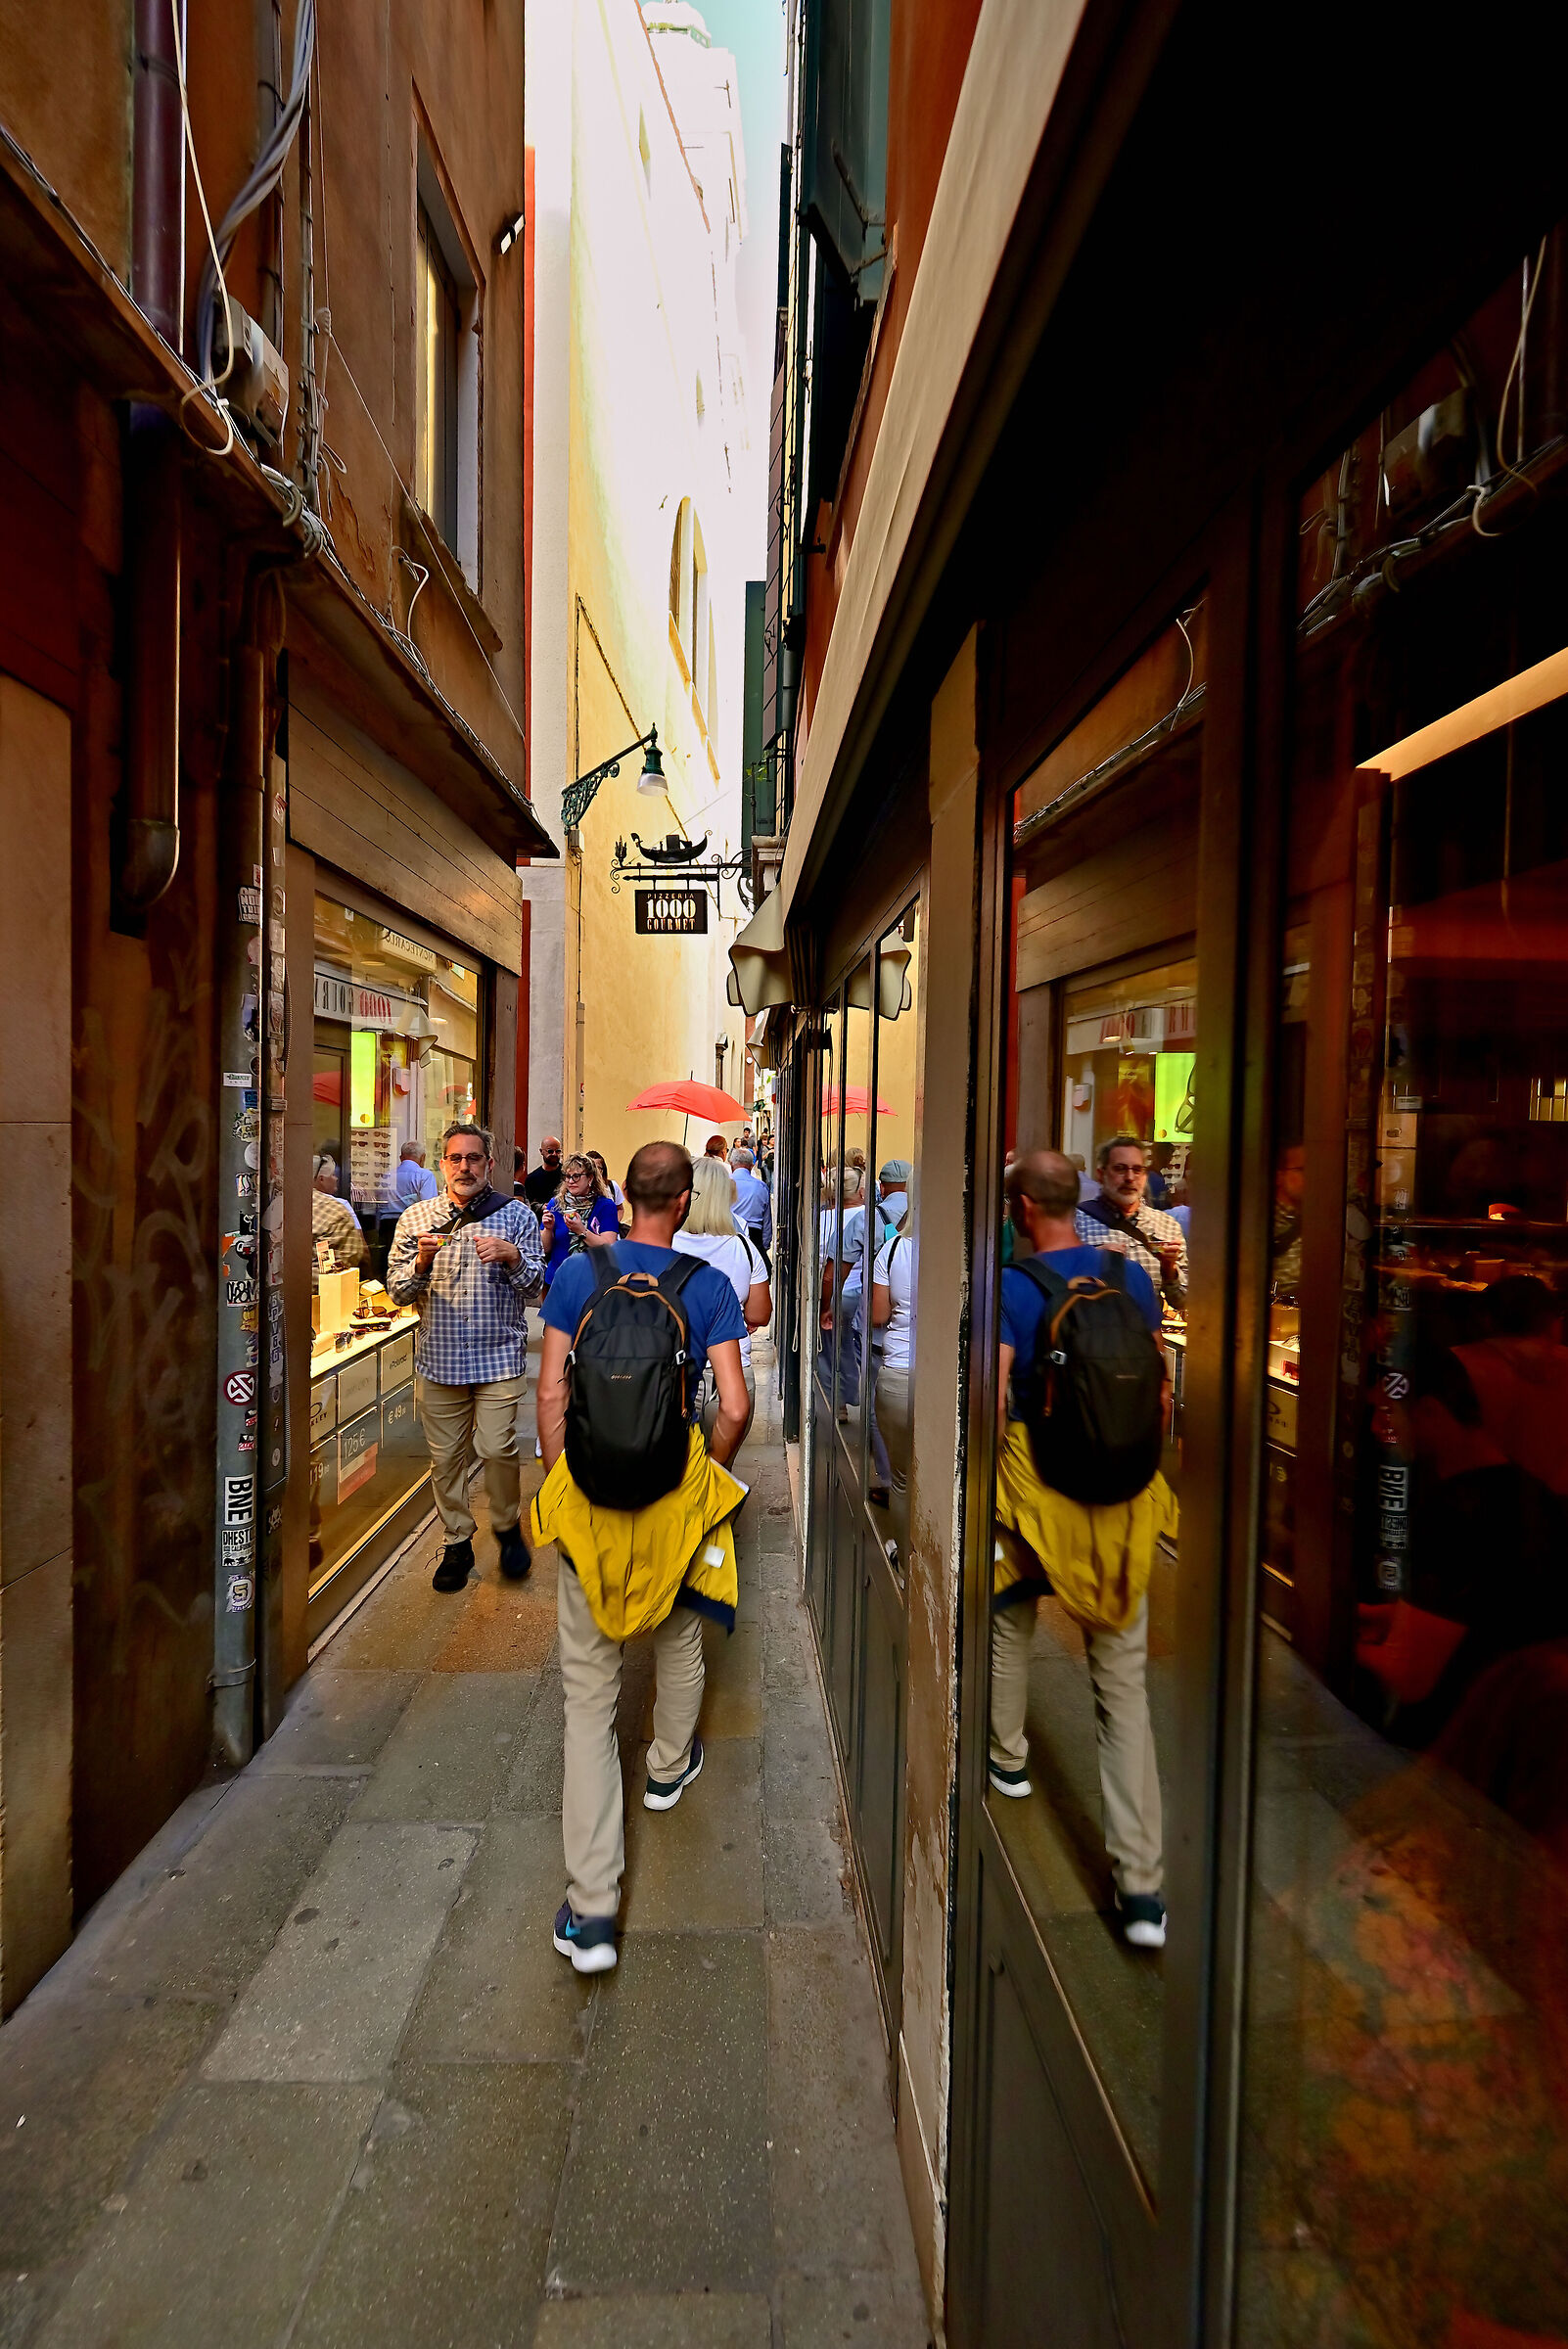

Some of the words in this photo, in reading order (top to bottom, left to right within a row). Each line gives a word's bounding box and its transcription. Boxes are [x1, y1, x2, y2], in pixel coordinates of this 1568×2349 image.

[646, 899, 697, 919] 1000
[646, 918, 696, 931] GOURMET
[228, 1477, 254, 1522] BNE
